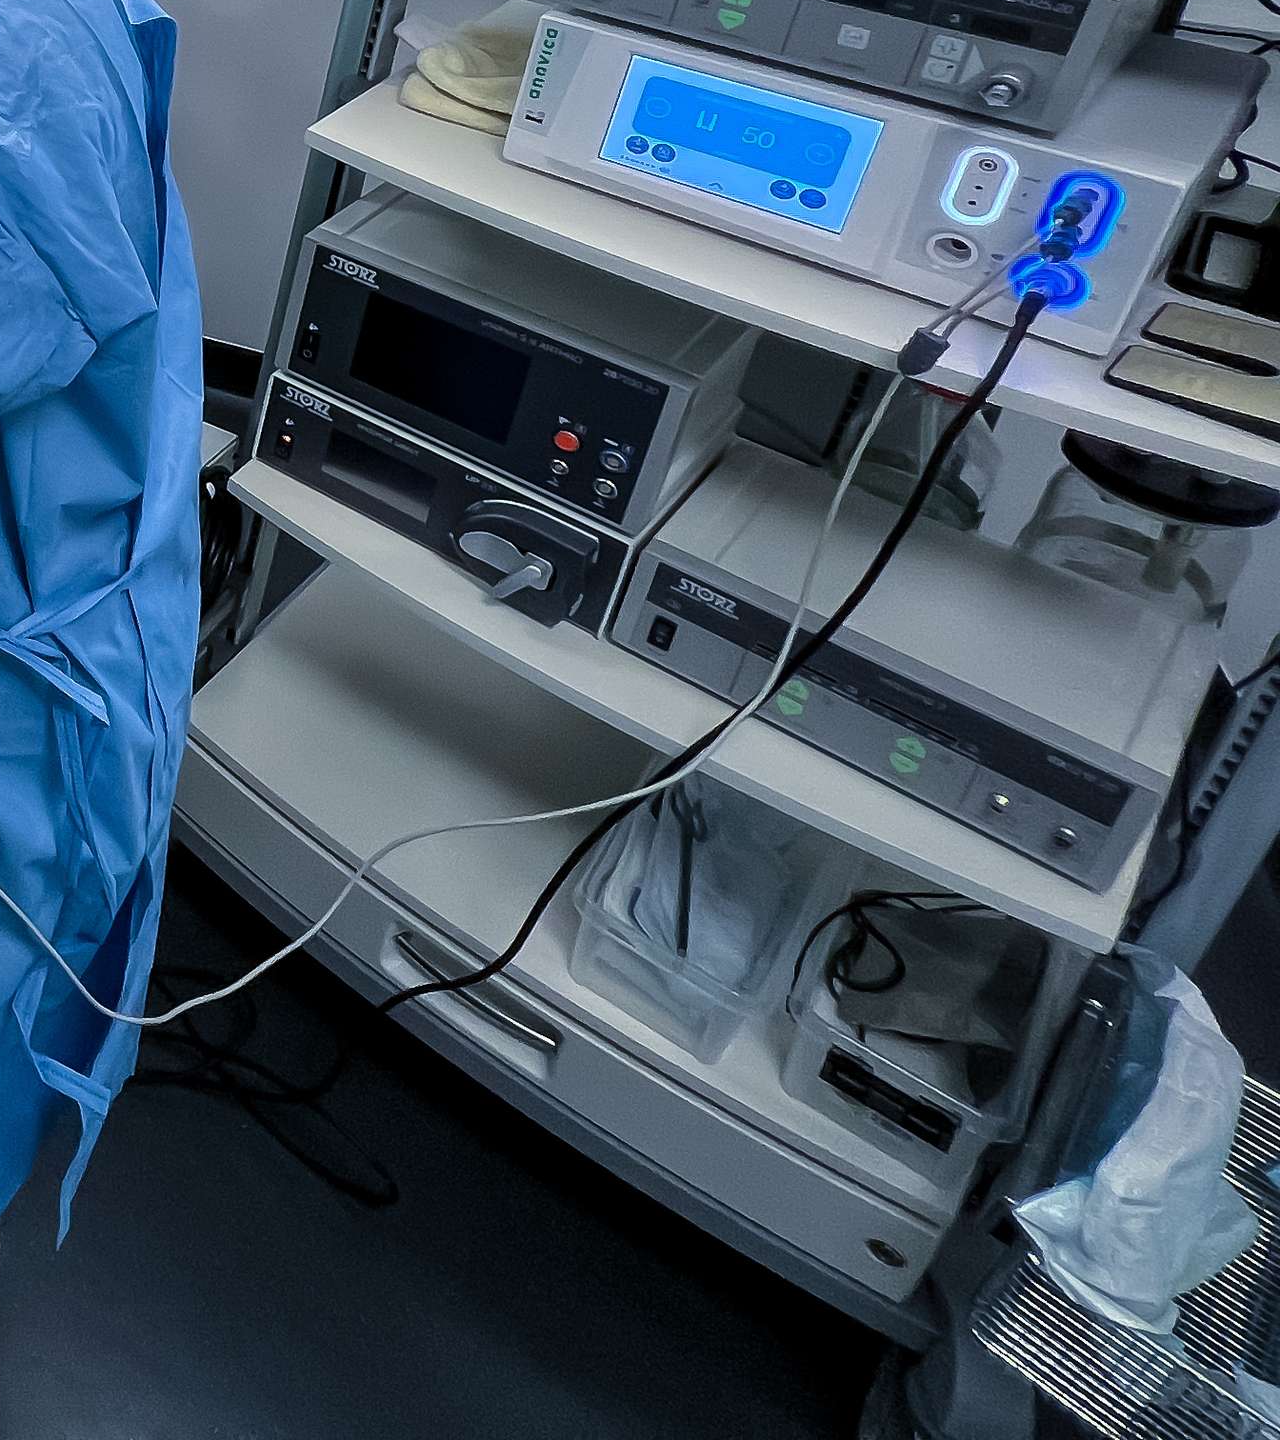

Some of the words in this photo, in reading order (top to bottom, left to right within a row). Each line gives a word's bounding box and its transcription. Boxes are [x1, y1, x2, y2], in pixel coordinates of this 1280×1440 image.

[742, 126, 775, 148] 50
[329, 254, 377, 283] STORZ
[286, 386, 330, 416] STORZ
[679, 578, 736, 613] STORZ
